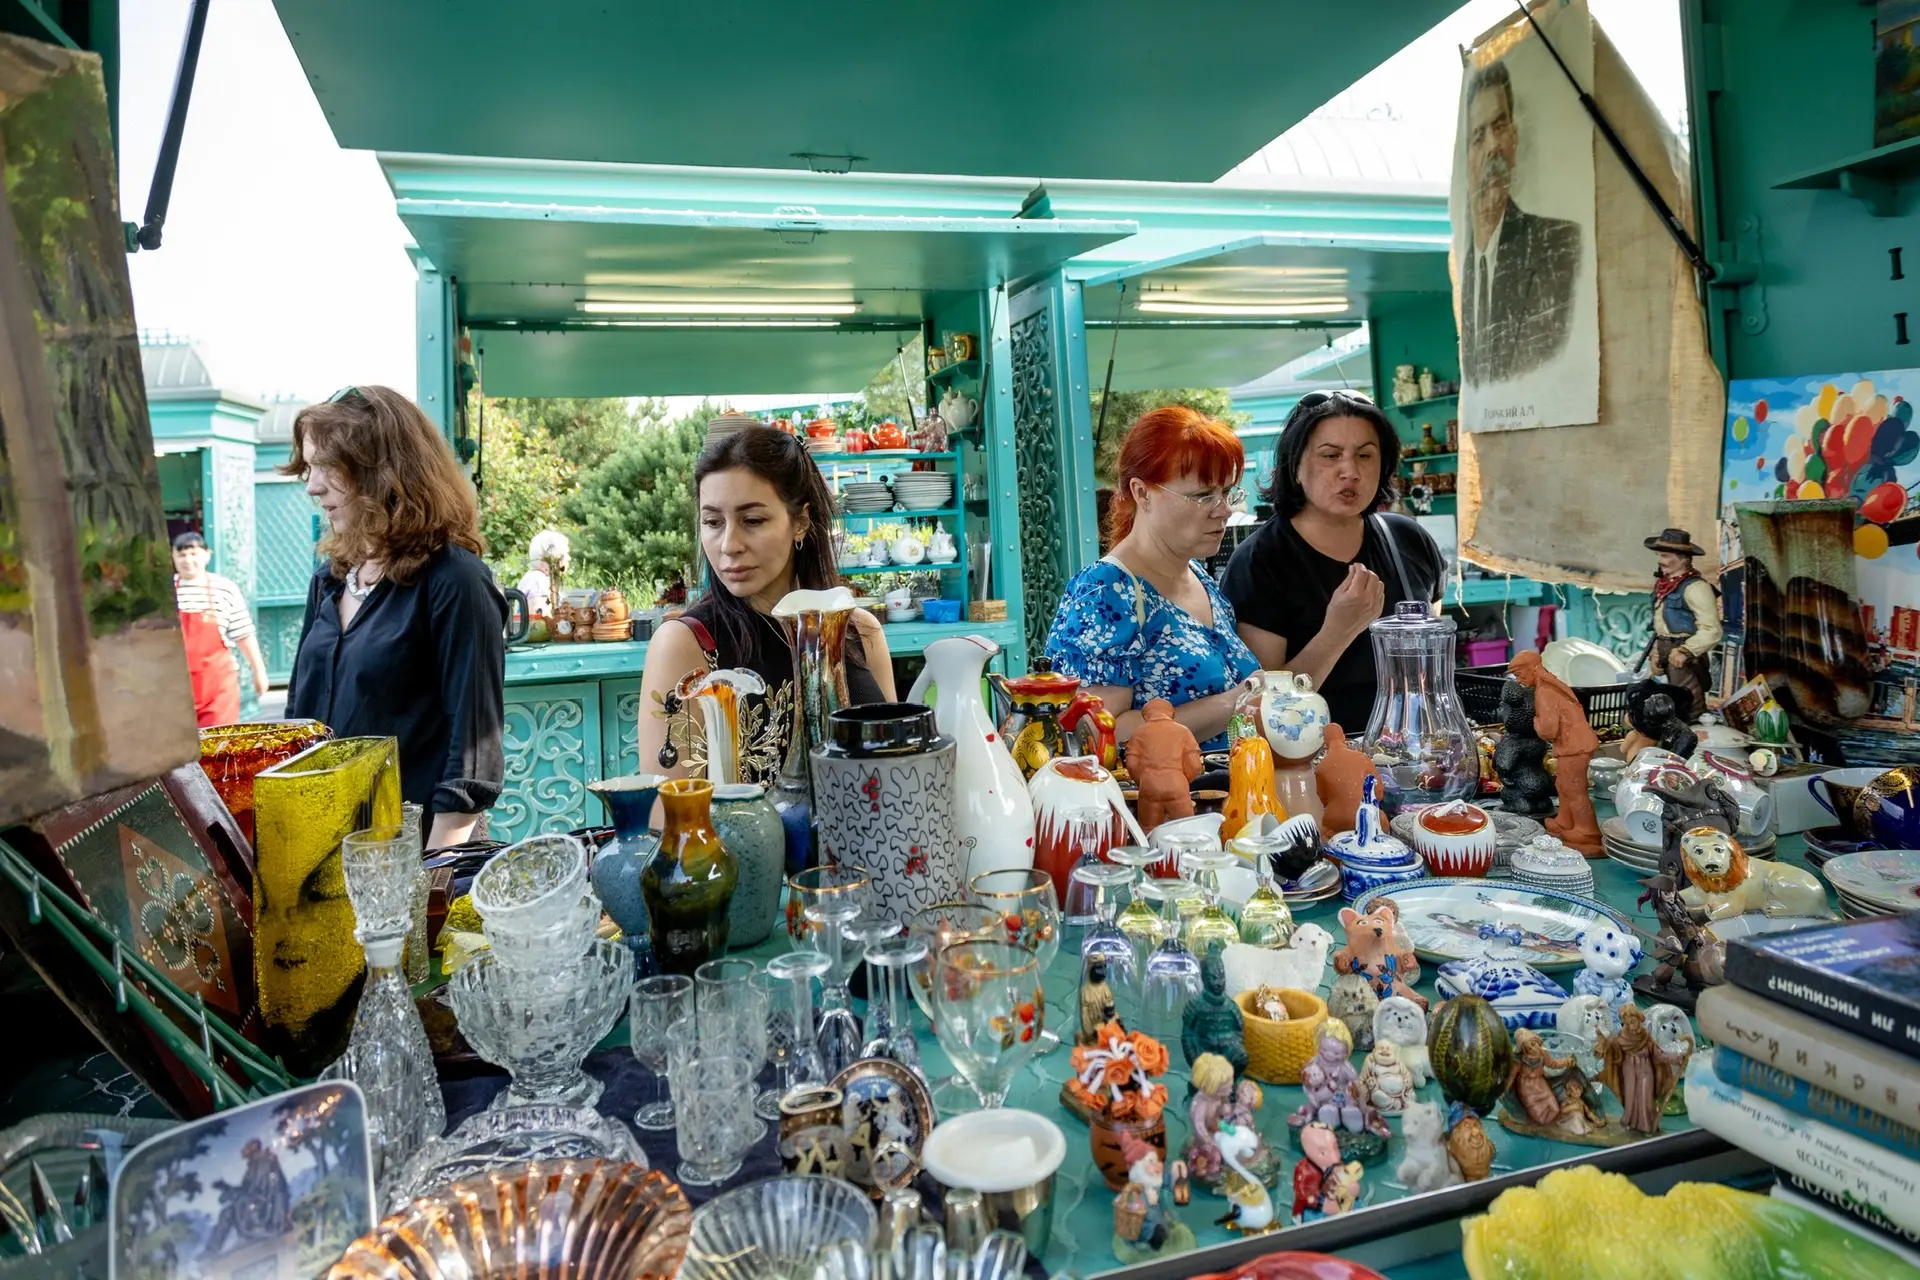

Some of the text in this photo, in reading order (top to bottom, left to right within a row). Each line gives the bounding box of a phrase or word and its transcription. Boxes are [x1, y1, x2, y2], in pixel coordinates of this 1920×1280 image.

[1768, 975, 1860, 1020] МИСТИЦИЗМ?
[1871, 1011, 1895, 1033] ЛИ
[1796, 1148, 1846, 1182] ЗОТОВ
